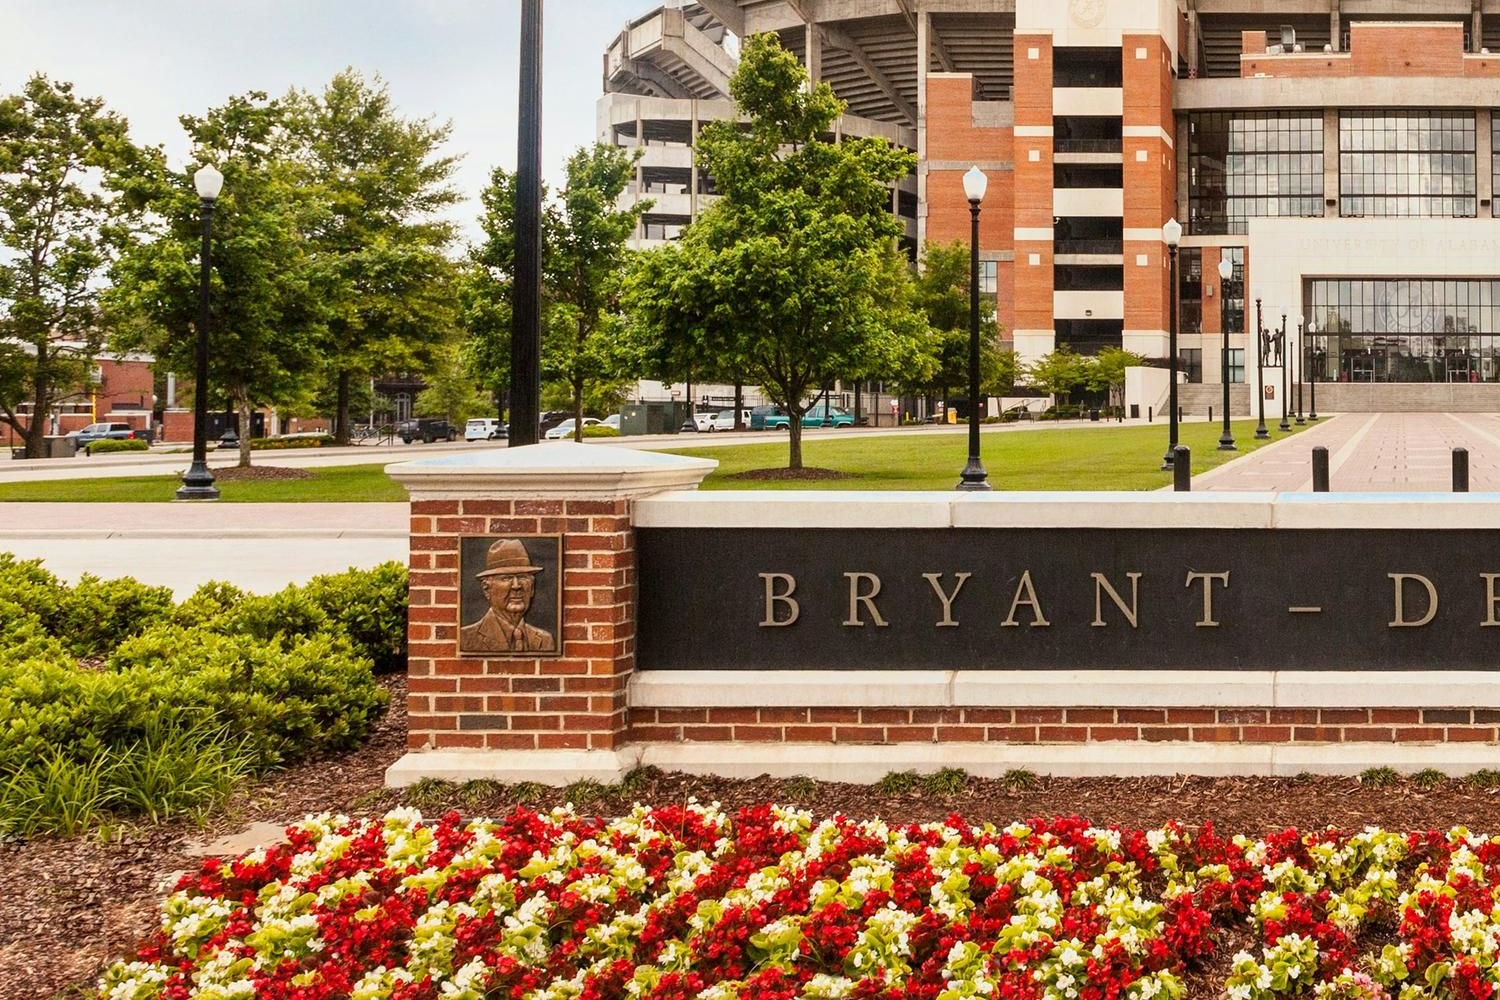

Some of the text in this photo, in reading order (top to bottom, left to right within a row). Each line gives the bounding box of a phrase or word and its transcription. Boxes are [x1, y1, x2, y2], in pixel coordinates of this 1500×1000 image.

[1301, 237, 1400, 251] UNIVERSITY
[1407, 237, 1428, 251] OF
[758, 570, 1231, 627] BRYANT
